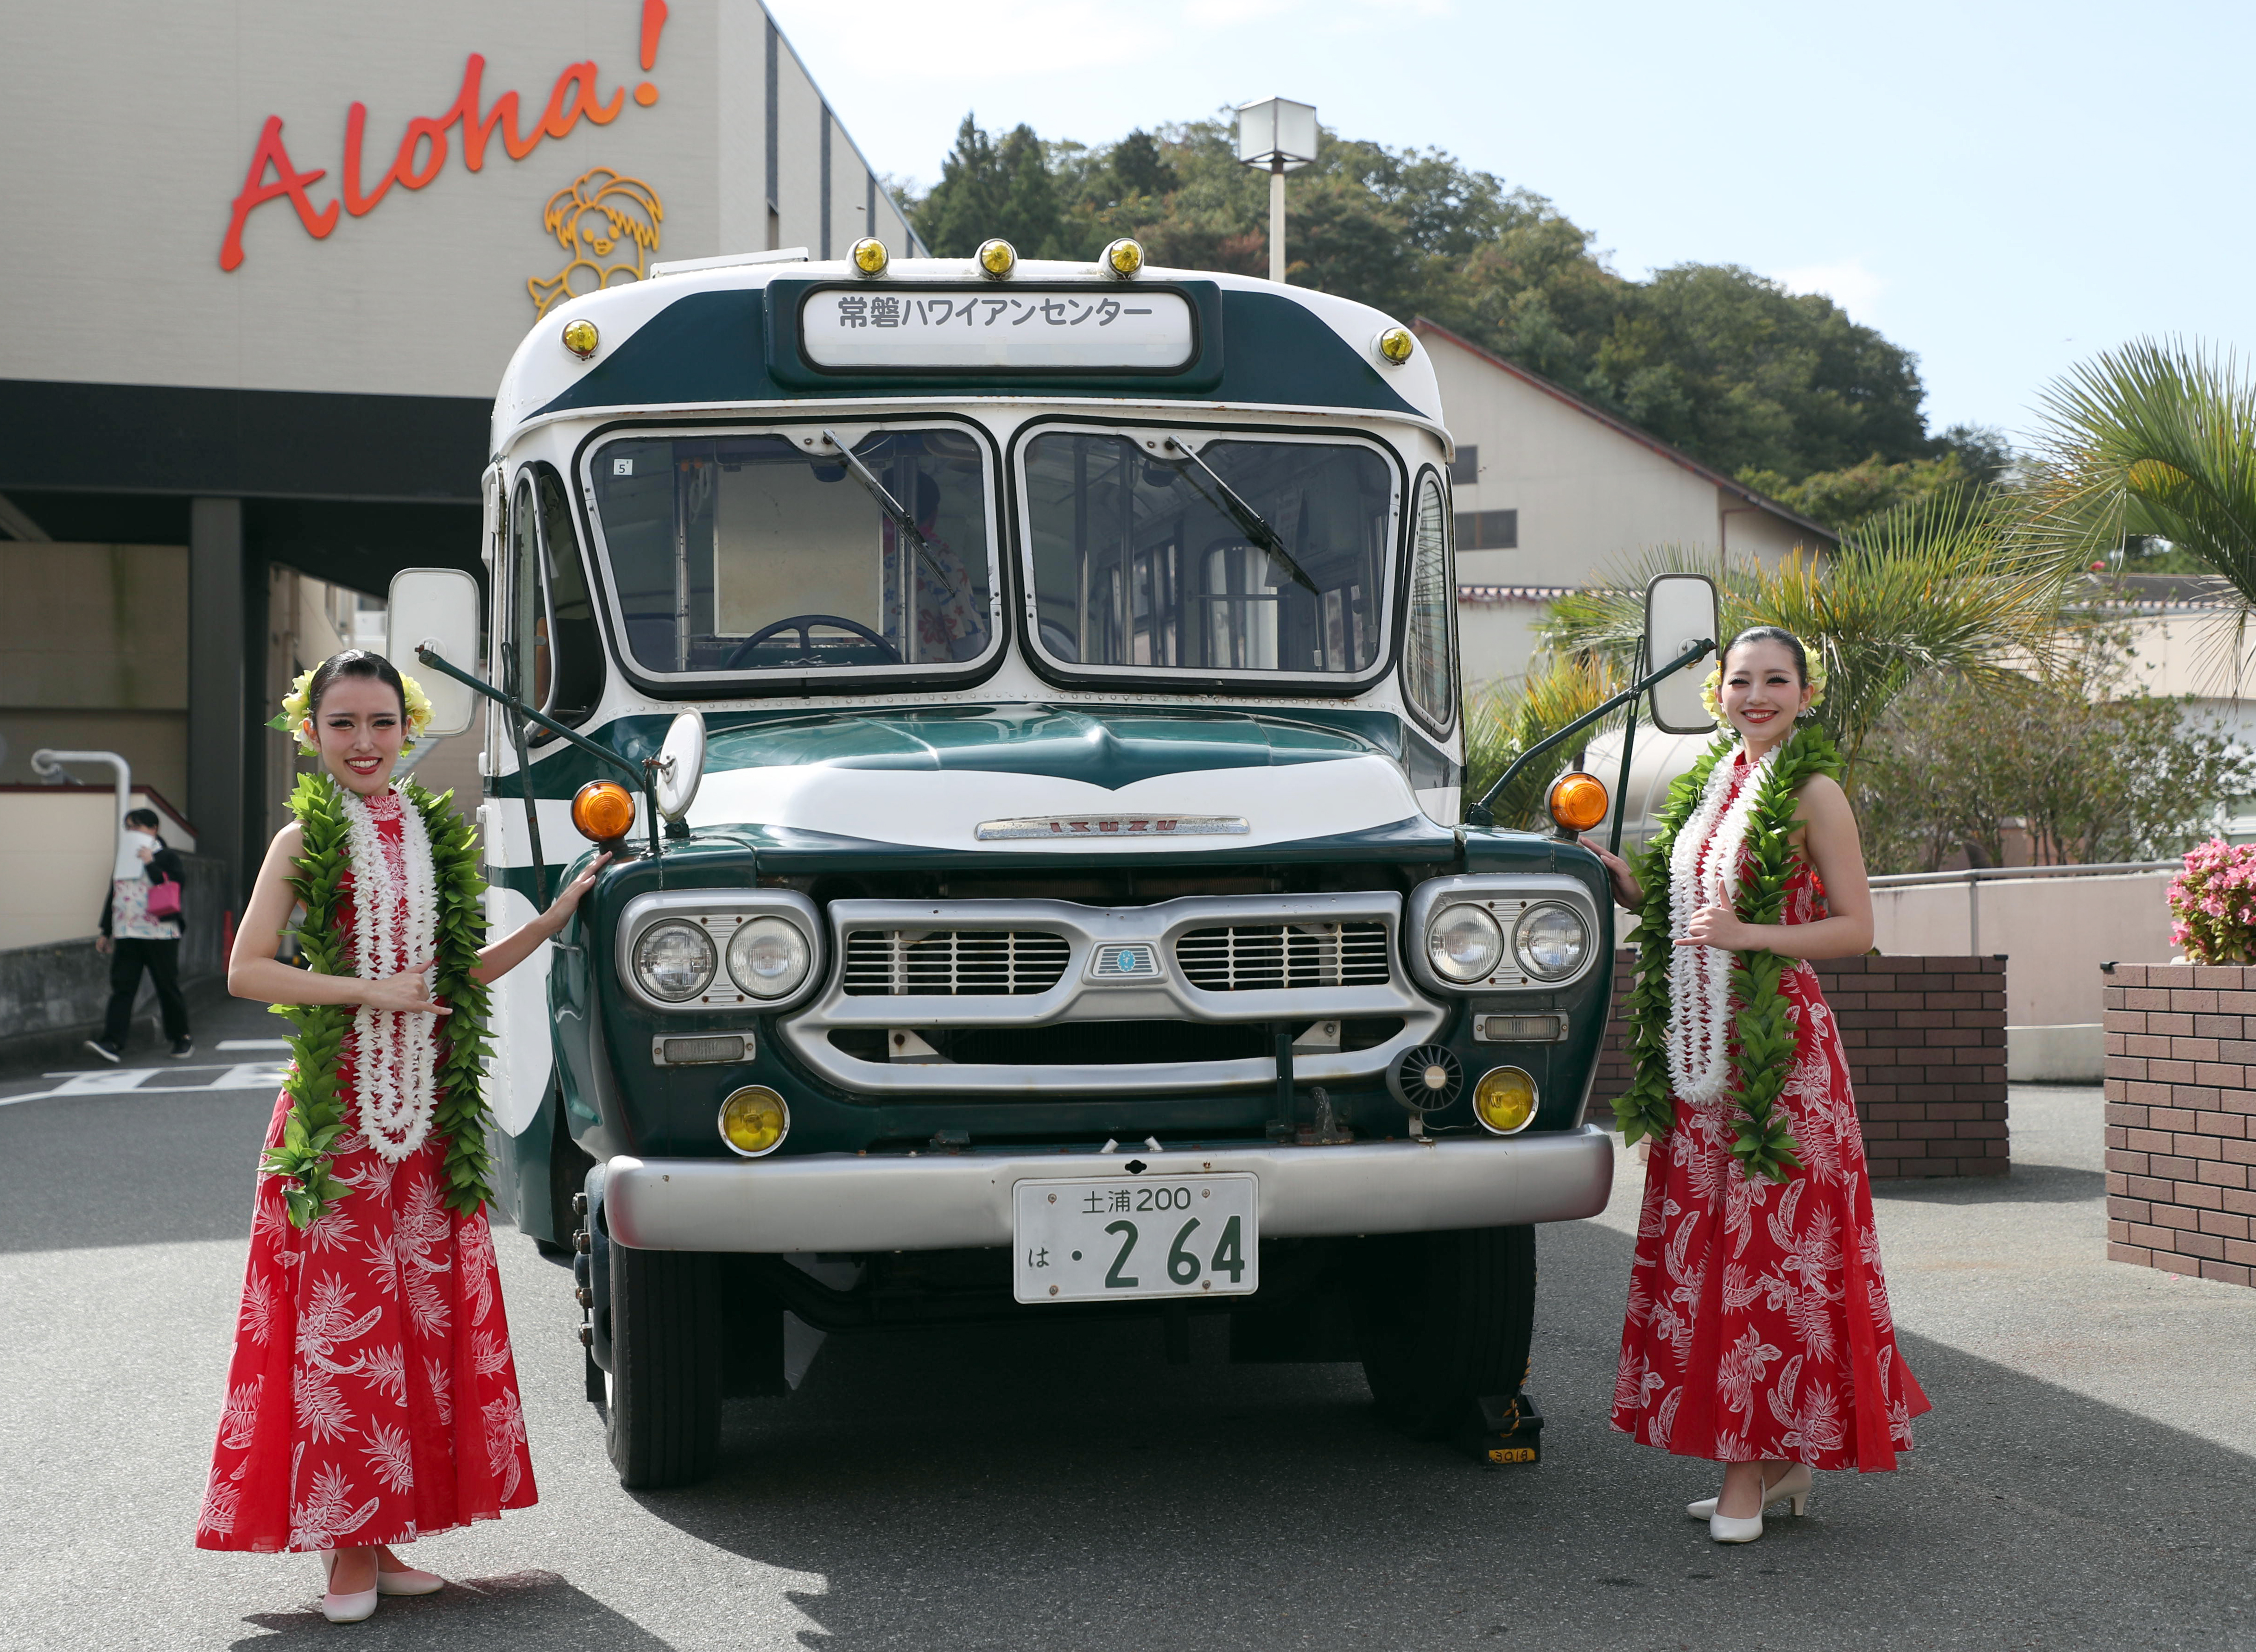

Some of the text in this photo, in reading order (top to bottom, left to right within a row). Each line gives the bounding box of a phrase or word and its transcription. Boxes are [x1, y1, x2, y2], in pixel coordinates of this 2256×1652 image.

[219, 0, 668, 272] Aloha!
[838, 296, 1153, 329] 常磐ハワイアンセンター
[619, 464, 625, 473] 5
[1050, 820, 1178, 833] ISUZU
[1028, 1246, 1050, 1269] は
